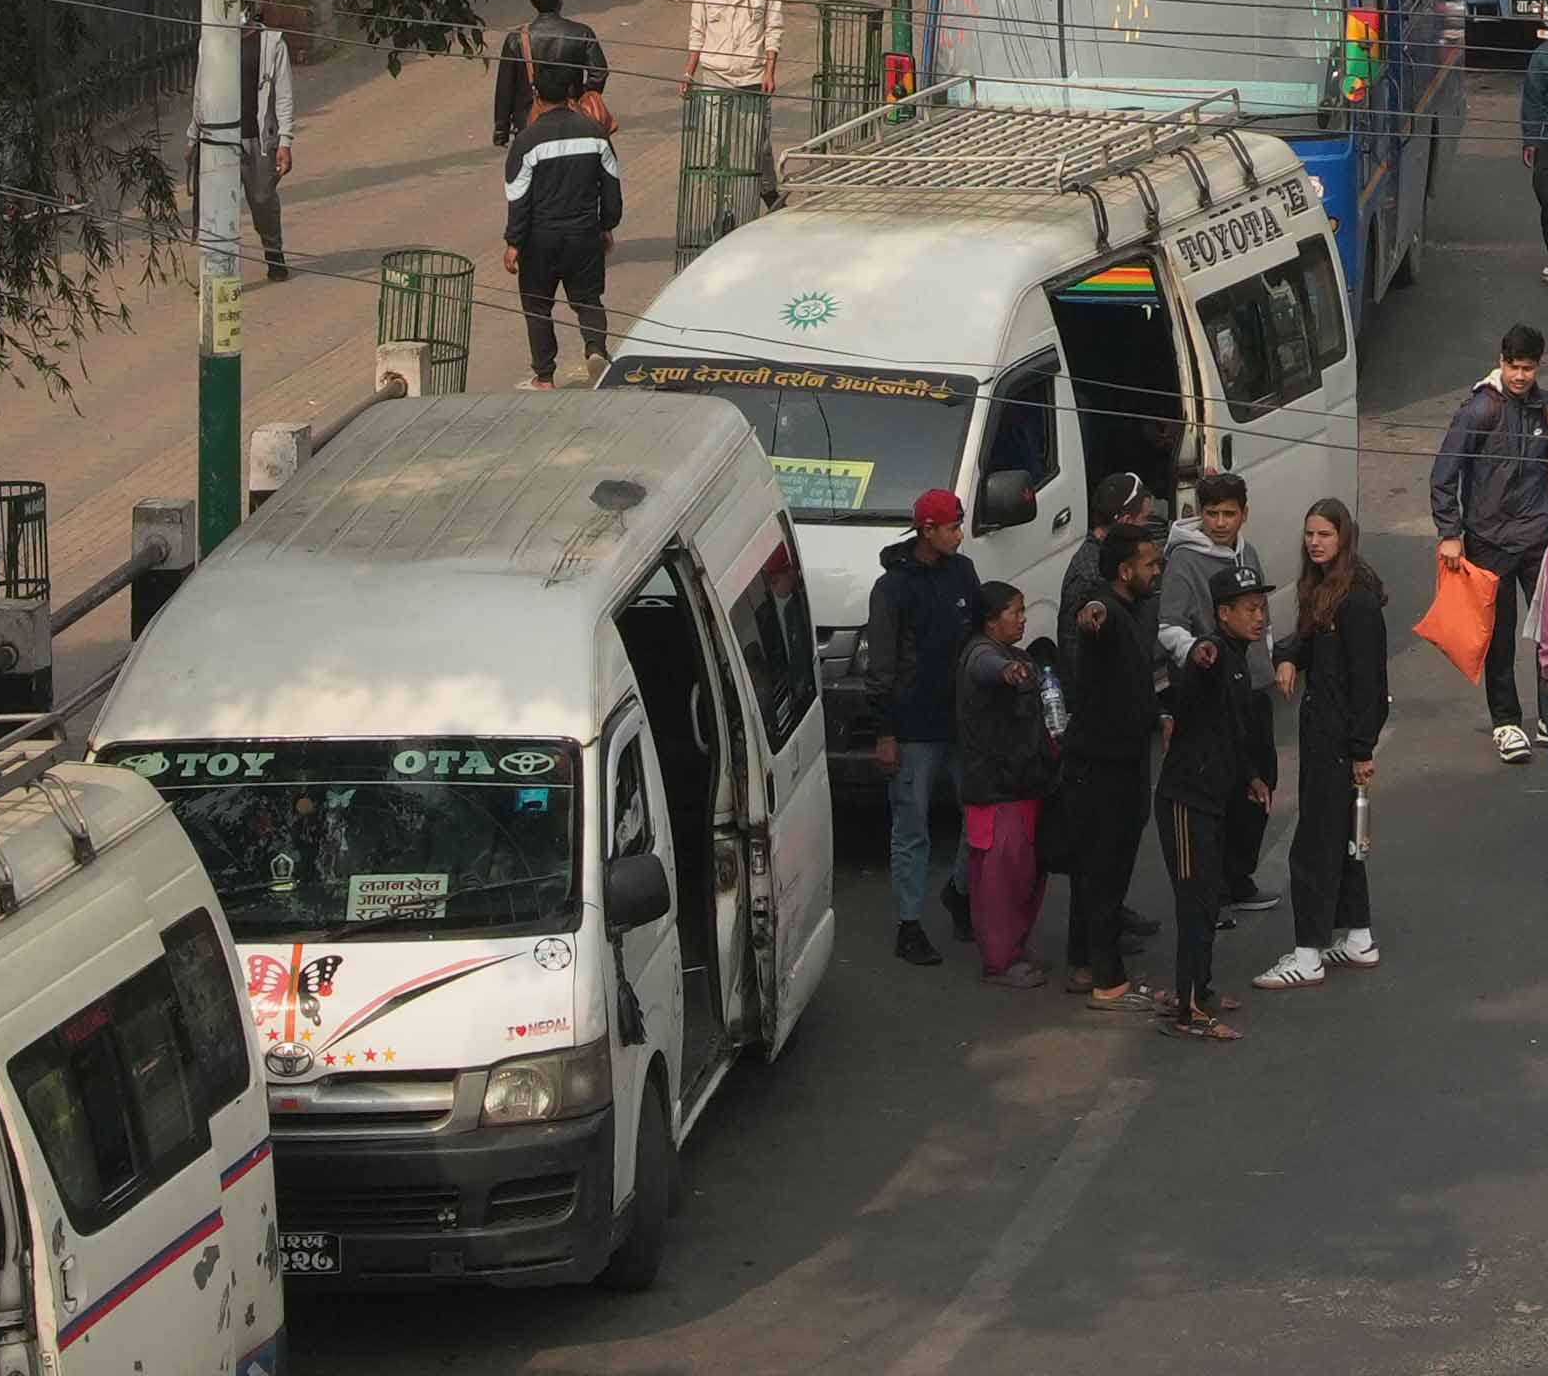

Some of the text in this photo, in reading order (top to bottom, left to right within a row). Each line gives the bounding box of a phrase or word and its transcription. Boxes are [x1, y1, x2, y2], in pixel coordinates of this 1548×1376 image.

[1176, 205, 1285, 273] TOYOTA
[692, 364, 773, 386] देउराली
[774, 370, 828, 388] दर्शन
[176, 750, 495, 778] TOY OTA
[527, 1016, 571, 1038] NEPAL
